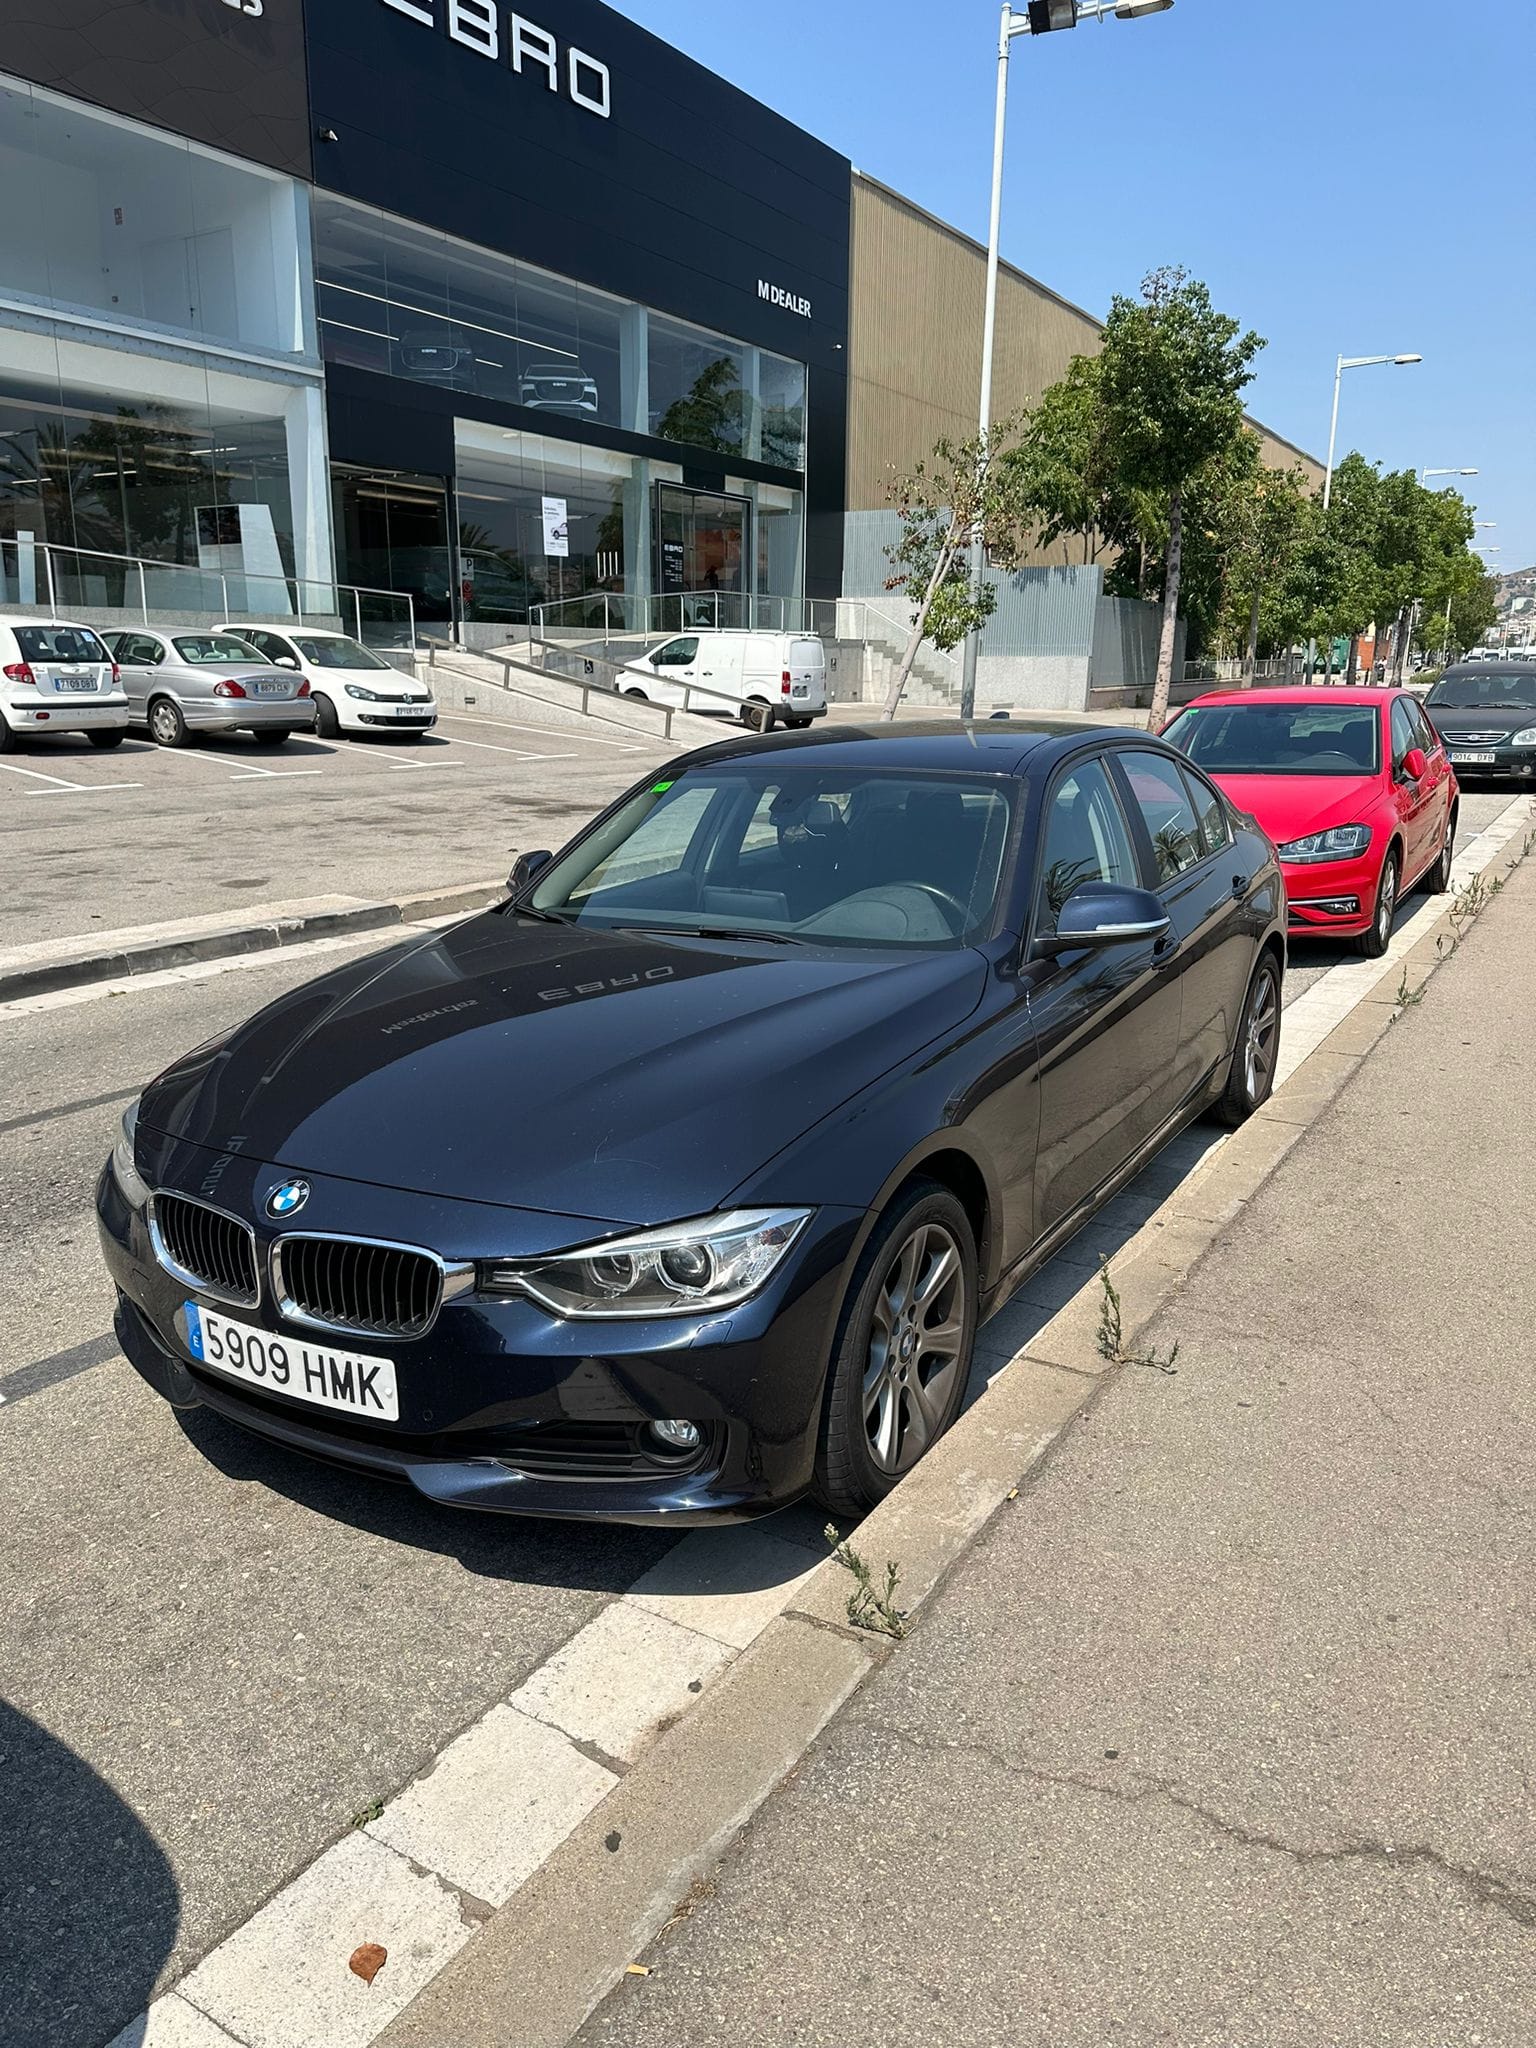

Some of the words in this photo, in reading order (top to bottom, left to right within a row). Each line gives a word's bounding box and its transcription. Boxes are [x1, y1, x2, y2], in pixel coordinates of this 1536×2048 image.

[758, 280, 769, 300] M
[771, 285, 811, 318] DEALER
[206, 1317, 290, 1385] 5909
[302, 1350, 385, 1410] HMK
